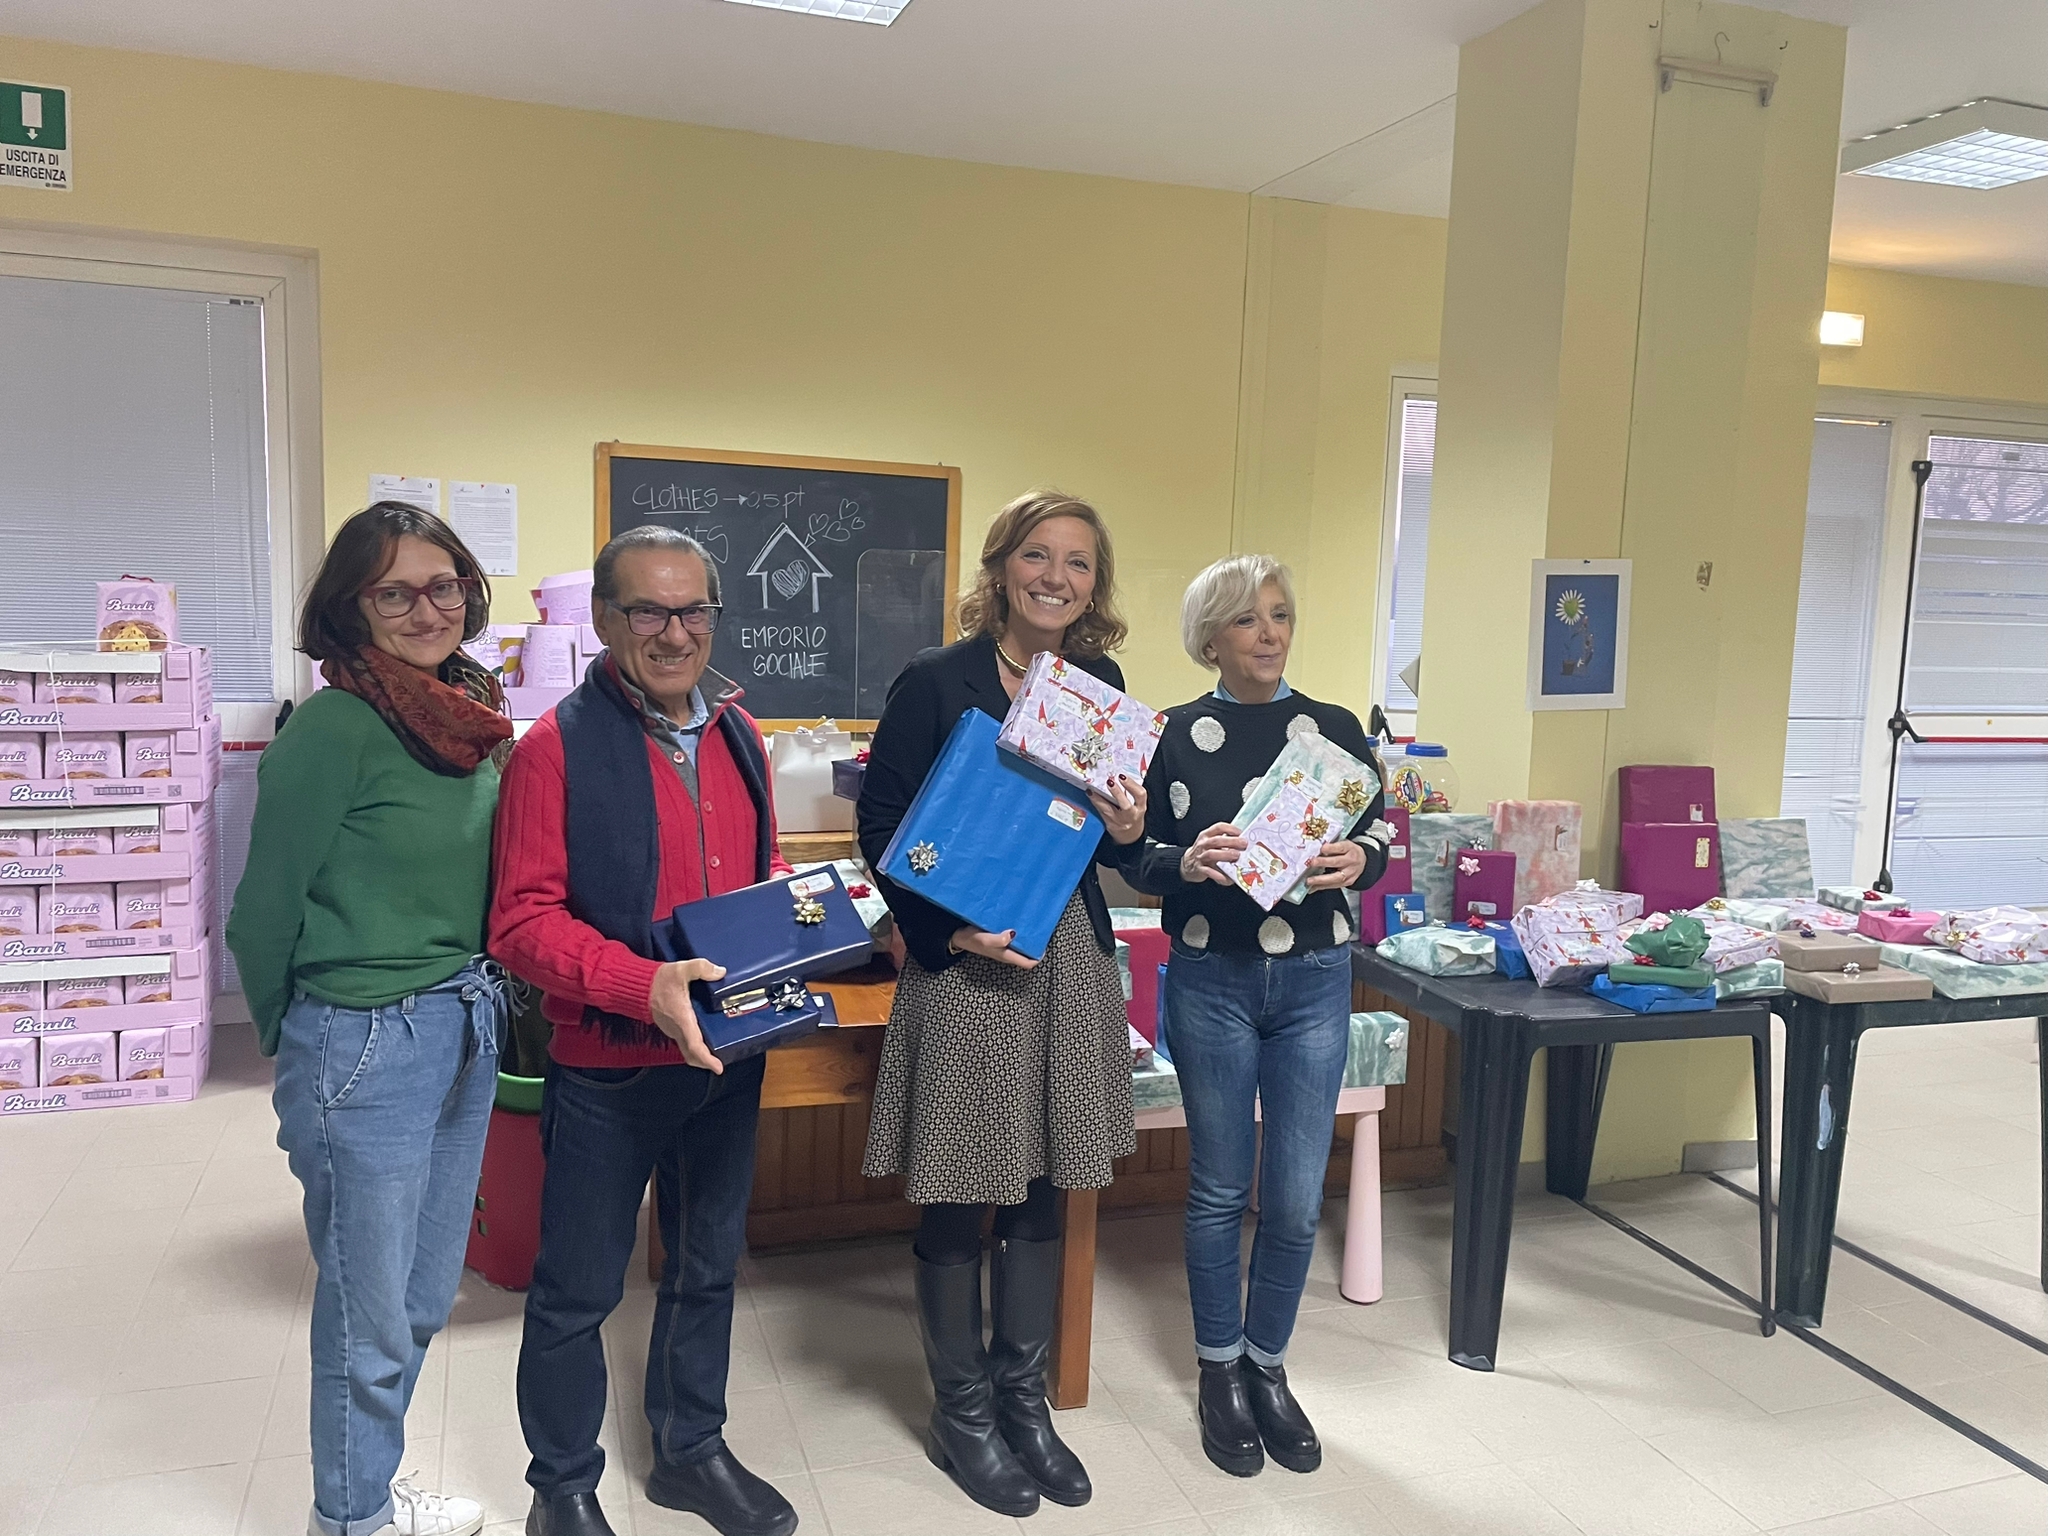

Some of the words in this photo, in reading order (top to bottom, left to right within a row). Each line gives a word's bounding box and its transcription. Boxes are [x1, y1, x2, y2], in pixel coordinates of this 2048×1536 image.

[6, 149, 45, 164] USCITA
[48, 154, 59, 166] DI
[0, 164, 66, 181] EMERGENZA
[632, 483, 719, 510] CLOTHES
[782, 484, 805, 518] pt
[106, 598, 155, 611] Bauli
[742, 626, 826, 648] EMPORIO
[753, 651, 829, 679] SOCIALE
[0, 709, 64, 726] Bauli
[56, 749, 107, 762] Bauli
[10, 784, 74, 802] Bauli
[1, 862, 63, 879] Bauli
[50, 903, 100, 916] Bauli
[3, 940, 66, 957] Bauli
[58, 979, 108, 991] Bauli
[13, 1016, 76, 1033] Bauli
[51, 1053, 101, 1067] Bauli
[3, 1094, 66, 1111] Bauli
